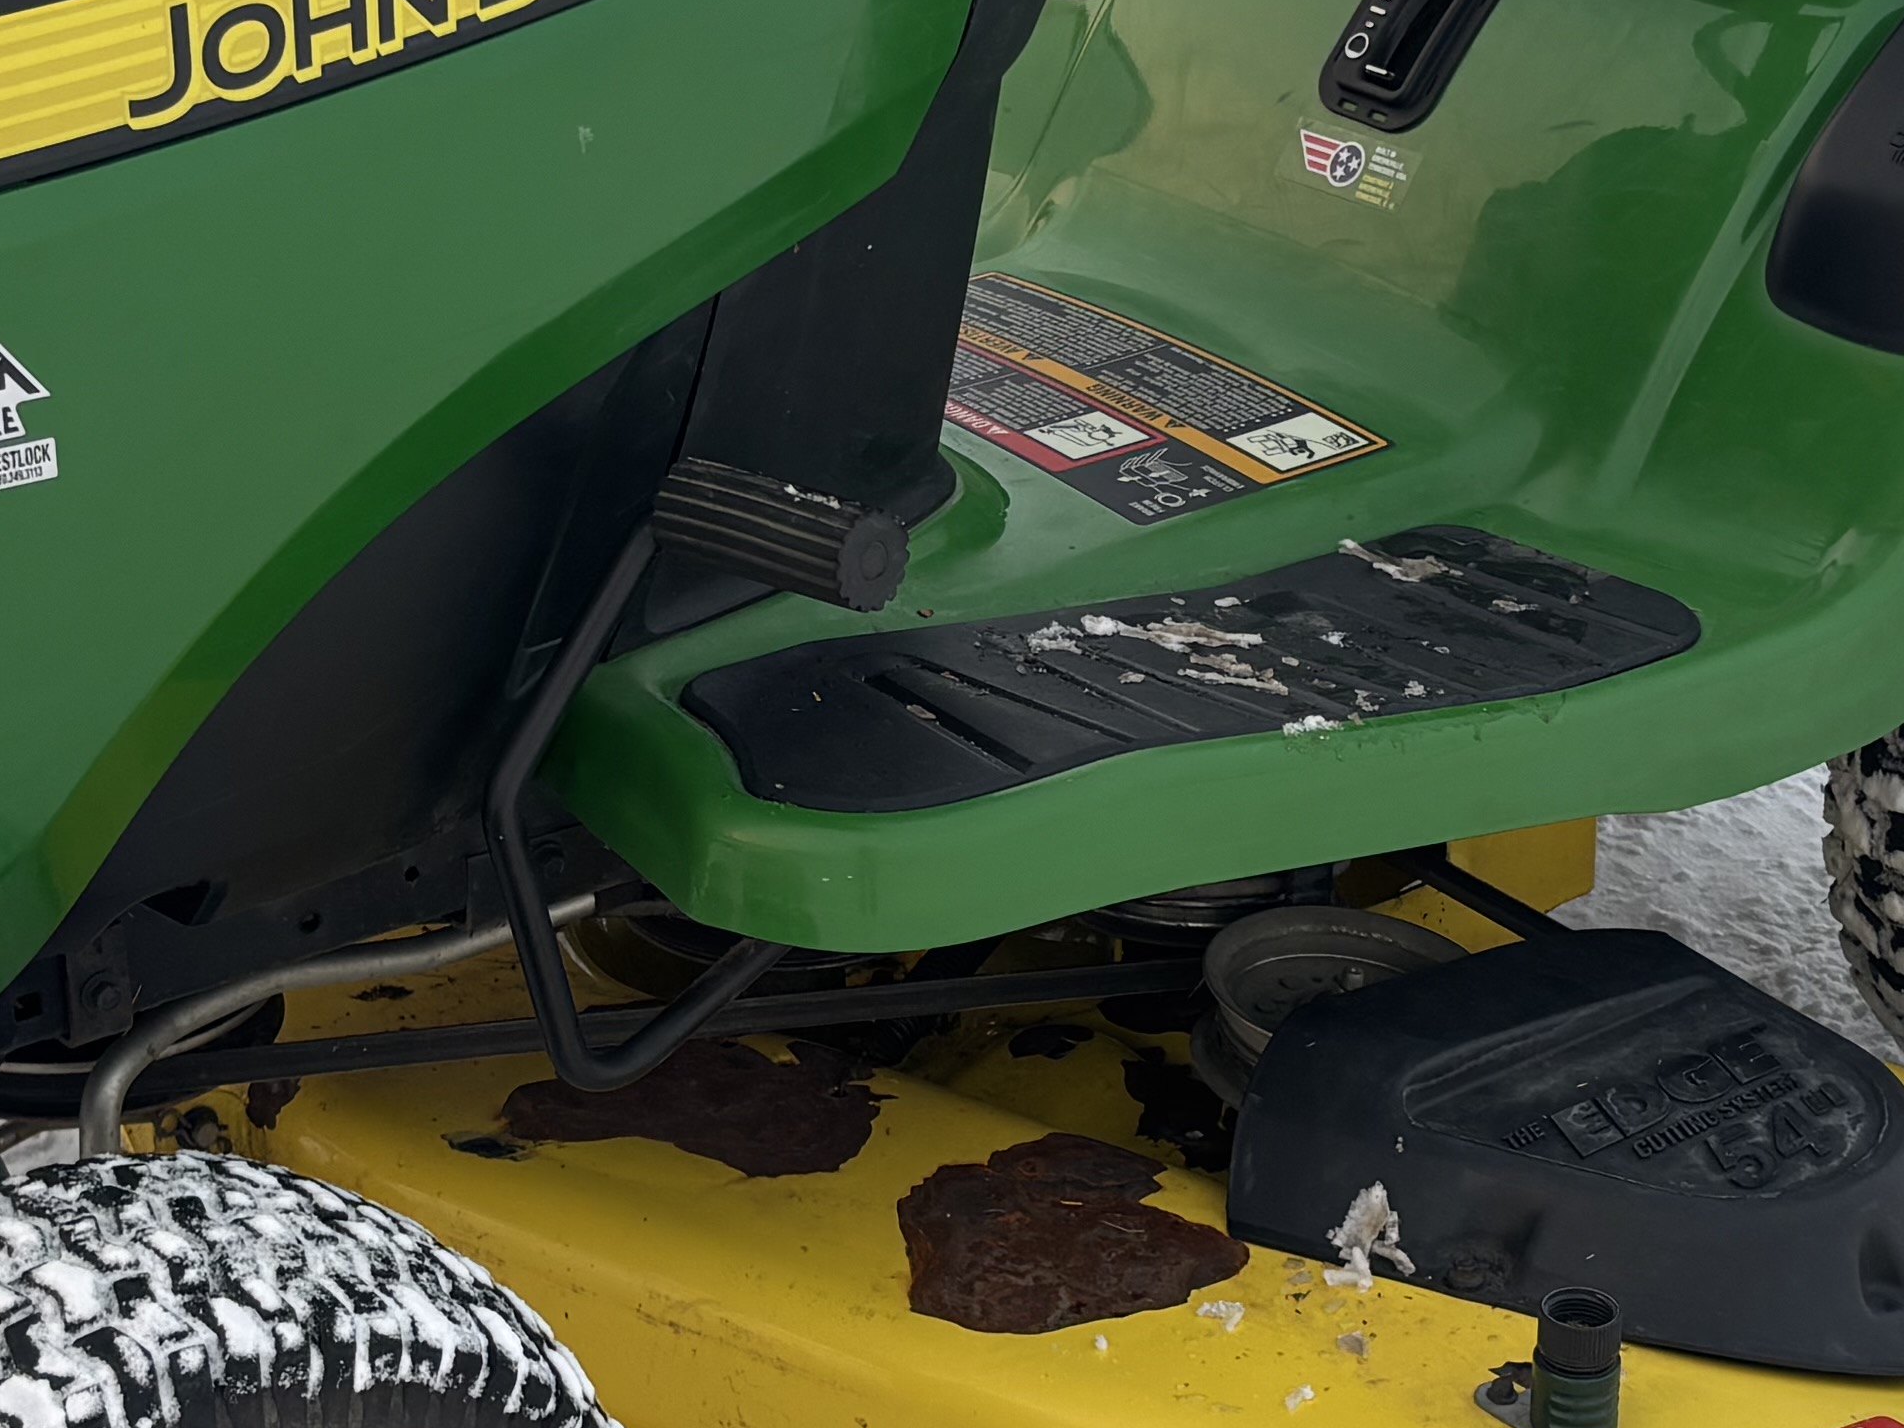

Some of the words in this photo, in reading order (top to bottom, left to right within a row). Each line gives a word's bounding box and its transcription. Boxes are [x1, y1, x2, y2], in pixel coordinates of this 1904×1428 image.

[1084, 382, 1169, 424] WARNING
[1501, 1123, 1546, 1151] THE
[1549, 1032, 1783, 1159] EDGE
[1632, 1111, 1718, 1159] CUTTING
[1718, 1071, 1803, 1119] SYSTEM
